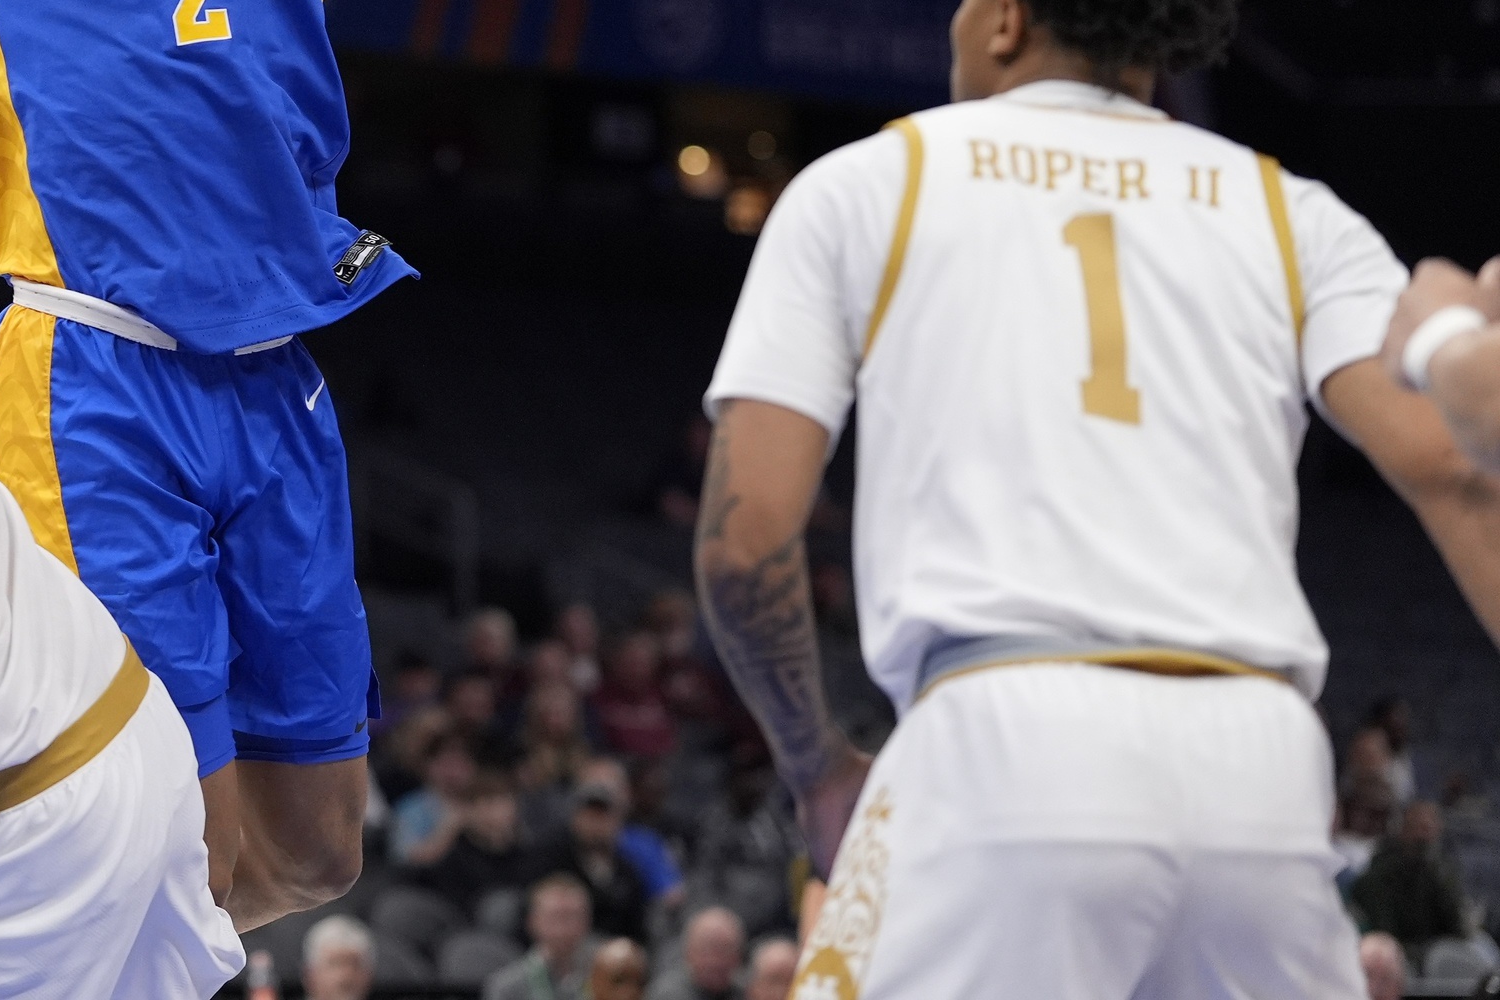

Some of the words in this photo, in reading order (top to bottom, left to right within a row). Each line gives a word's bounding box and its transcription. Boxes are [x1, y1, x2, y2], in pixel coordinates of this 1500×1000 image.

[968, 137, 1152, 200] ROPER
[1187, 166, 1222, 208] II
[1062, 211, 1143, 428] 1
